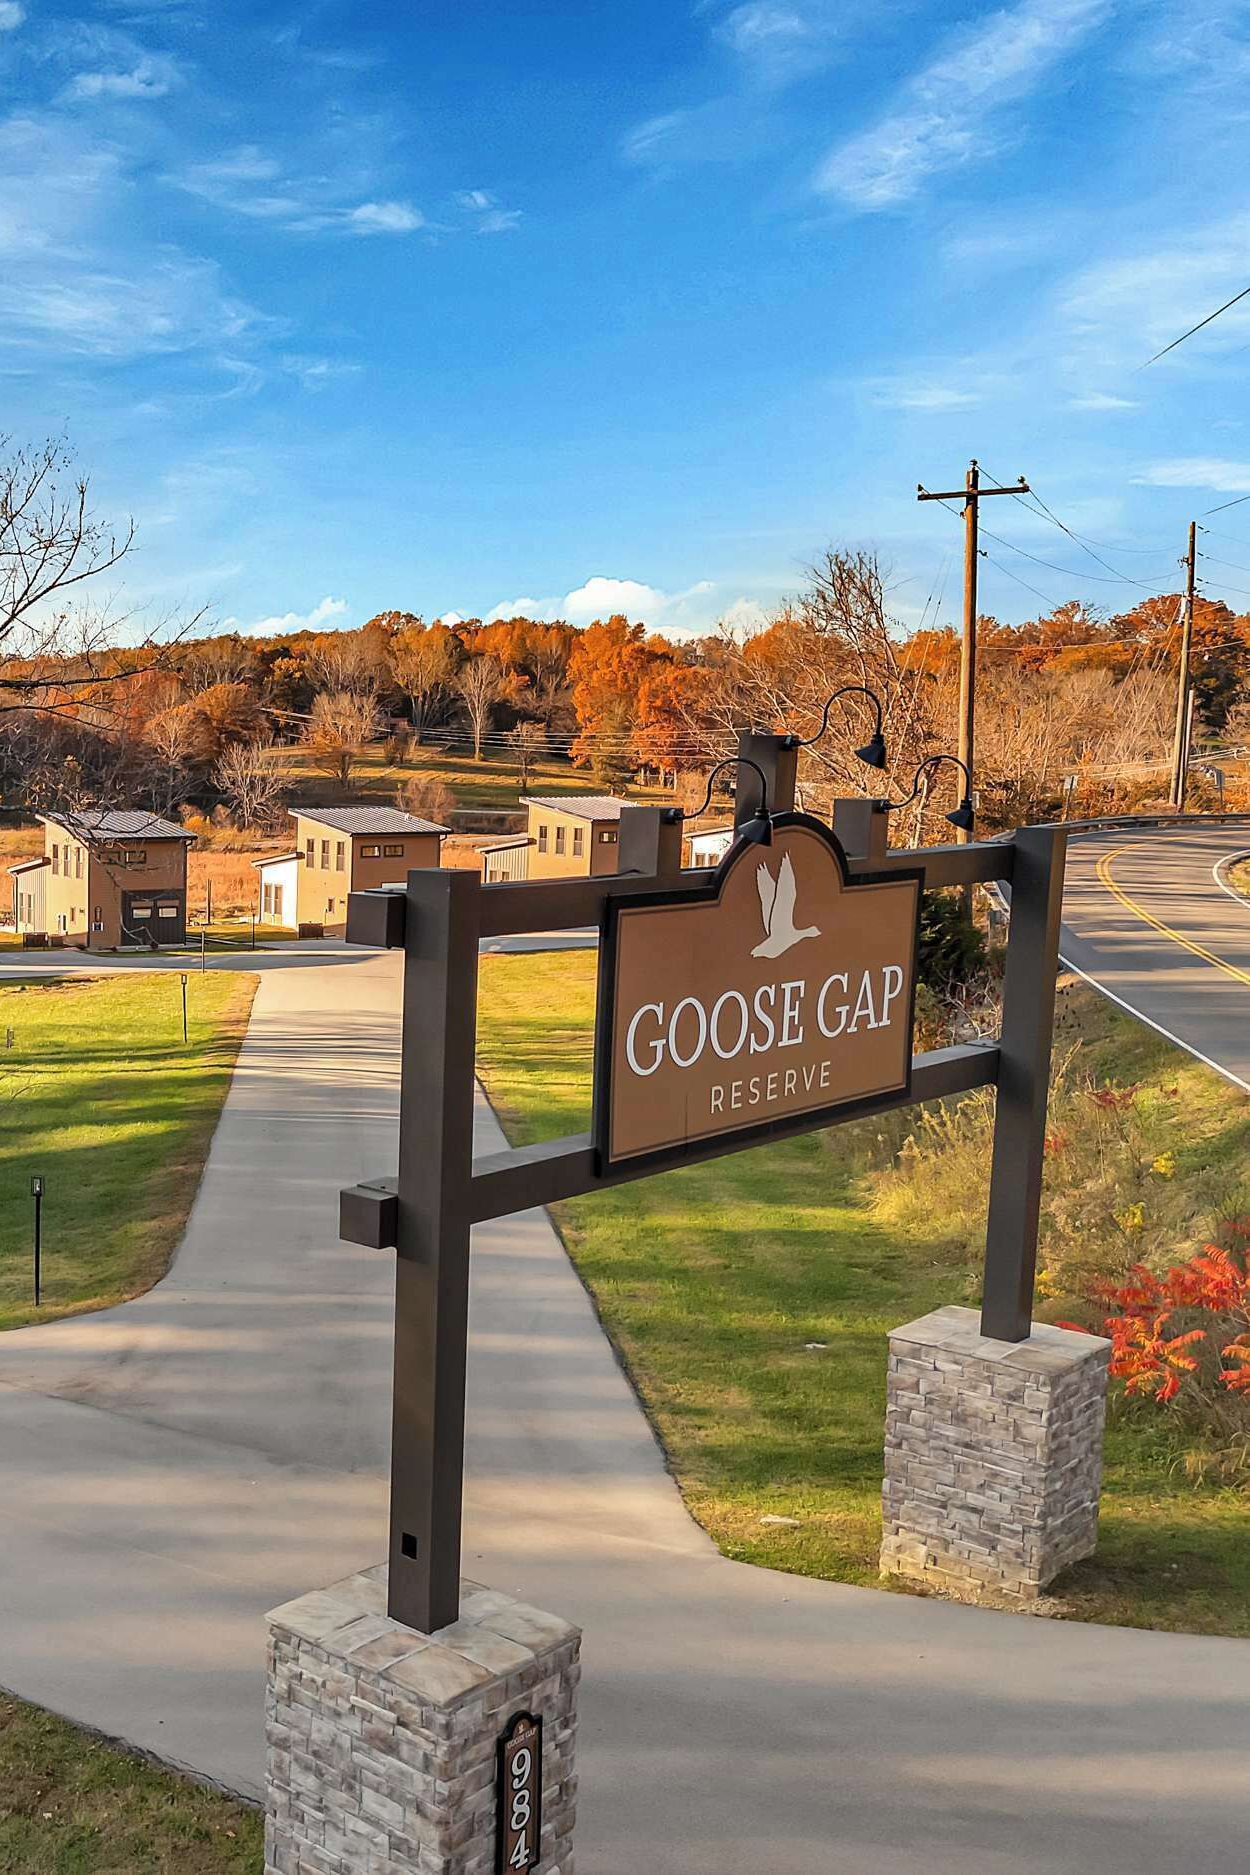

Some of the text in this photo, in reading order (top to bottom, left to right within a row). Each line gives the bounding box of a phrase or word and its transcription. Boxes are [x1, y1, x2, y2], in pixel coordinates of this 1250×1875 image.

[626, 965, 903, 1076] GOOSE GAP
[710, 1061, 831, 1114] RESERVE
[510, 1748, 531, 1869] 984
